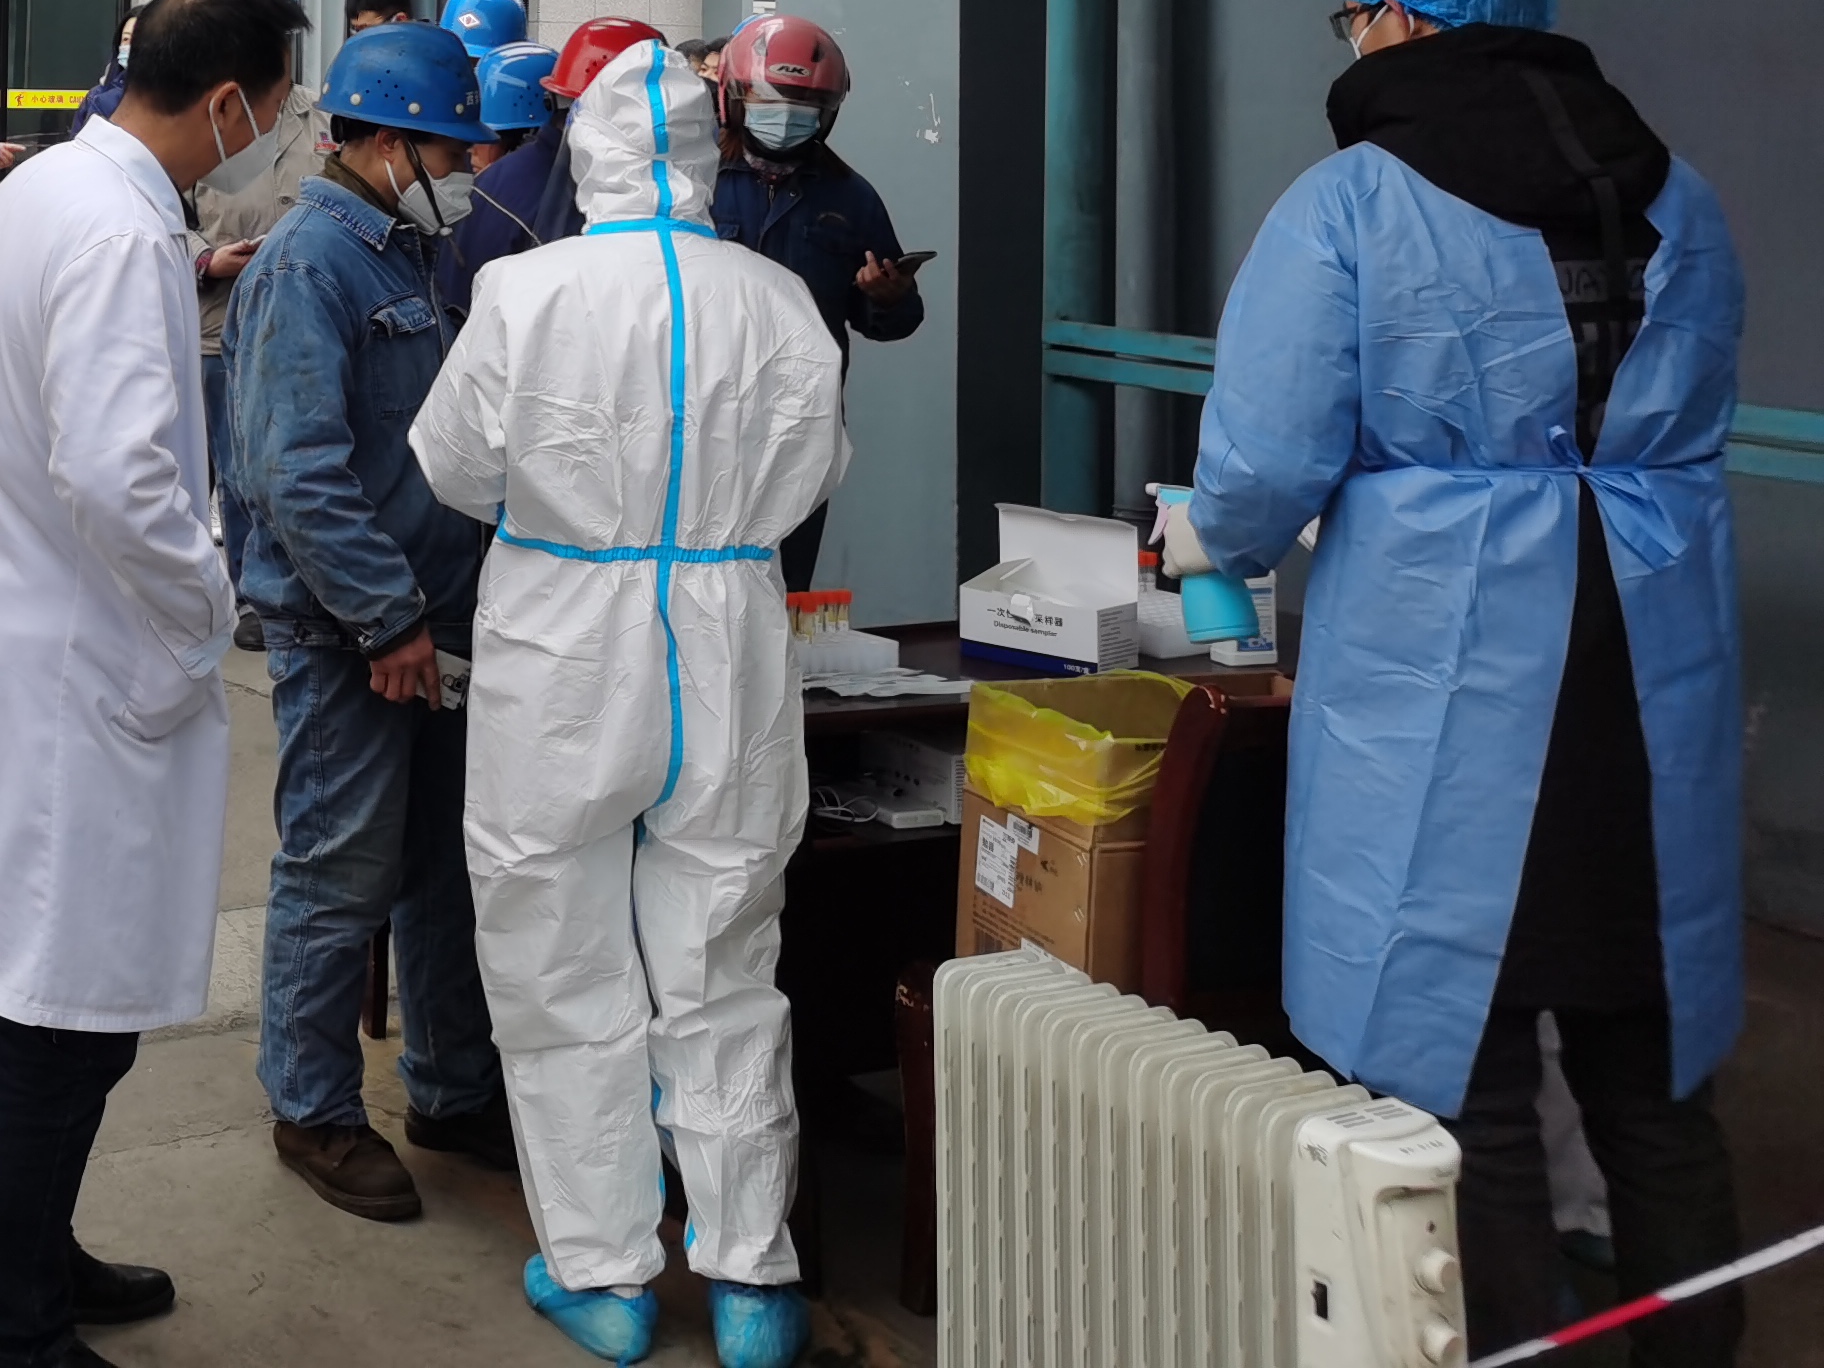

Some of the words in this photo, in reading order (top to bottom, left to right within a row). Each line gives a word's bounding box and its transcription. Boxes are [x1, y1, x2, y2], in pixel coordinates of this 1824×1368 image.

[986, 608, 1063, 627] 一次采样器
